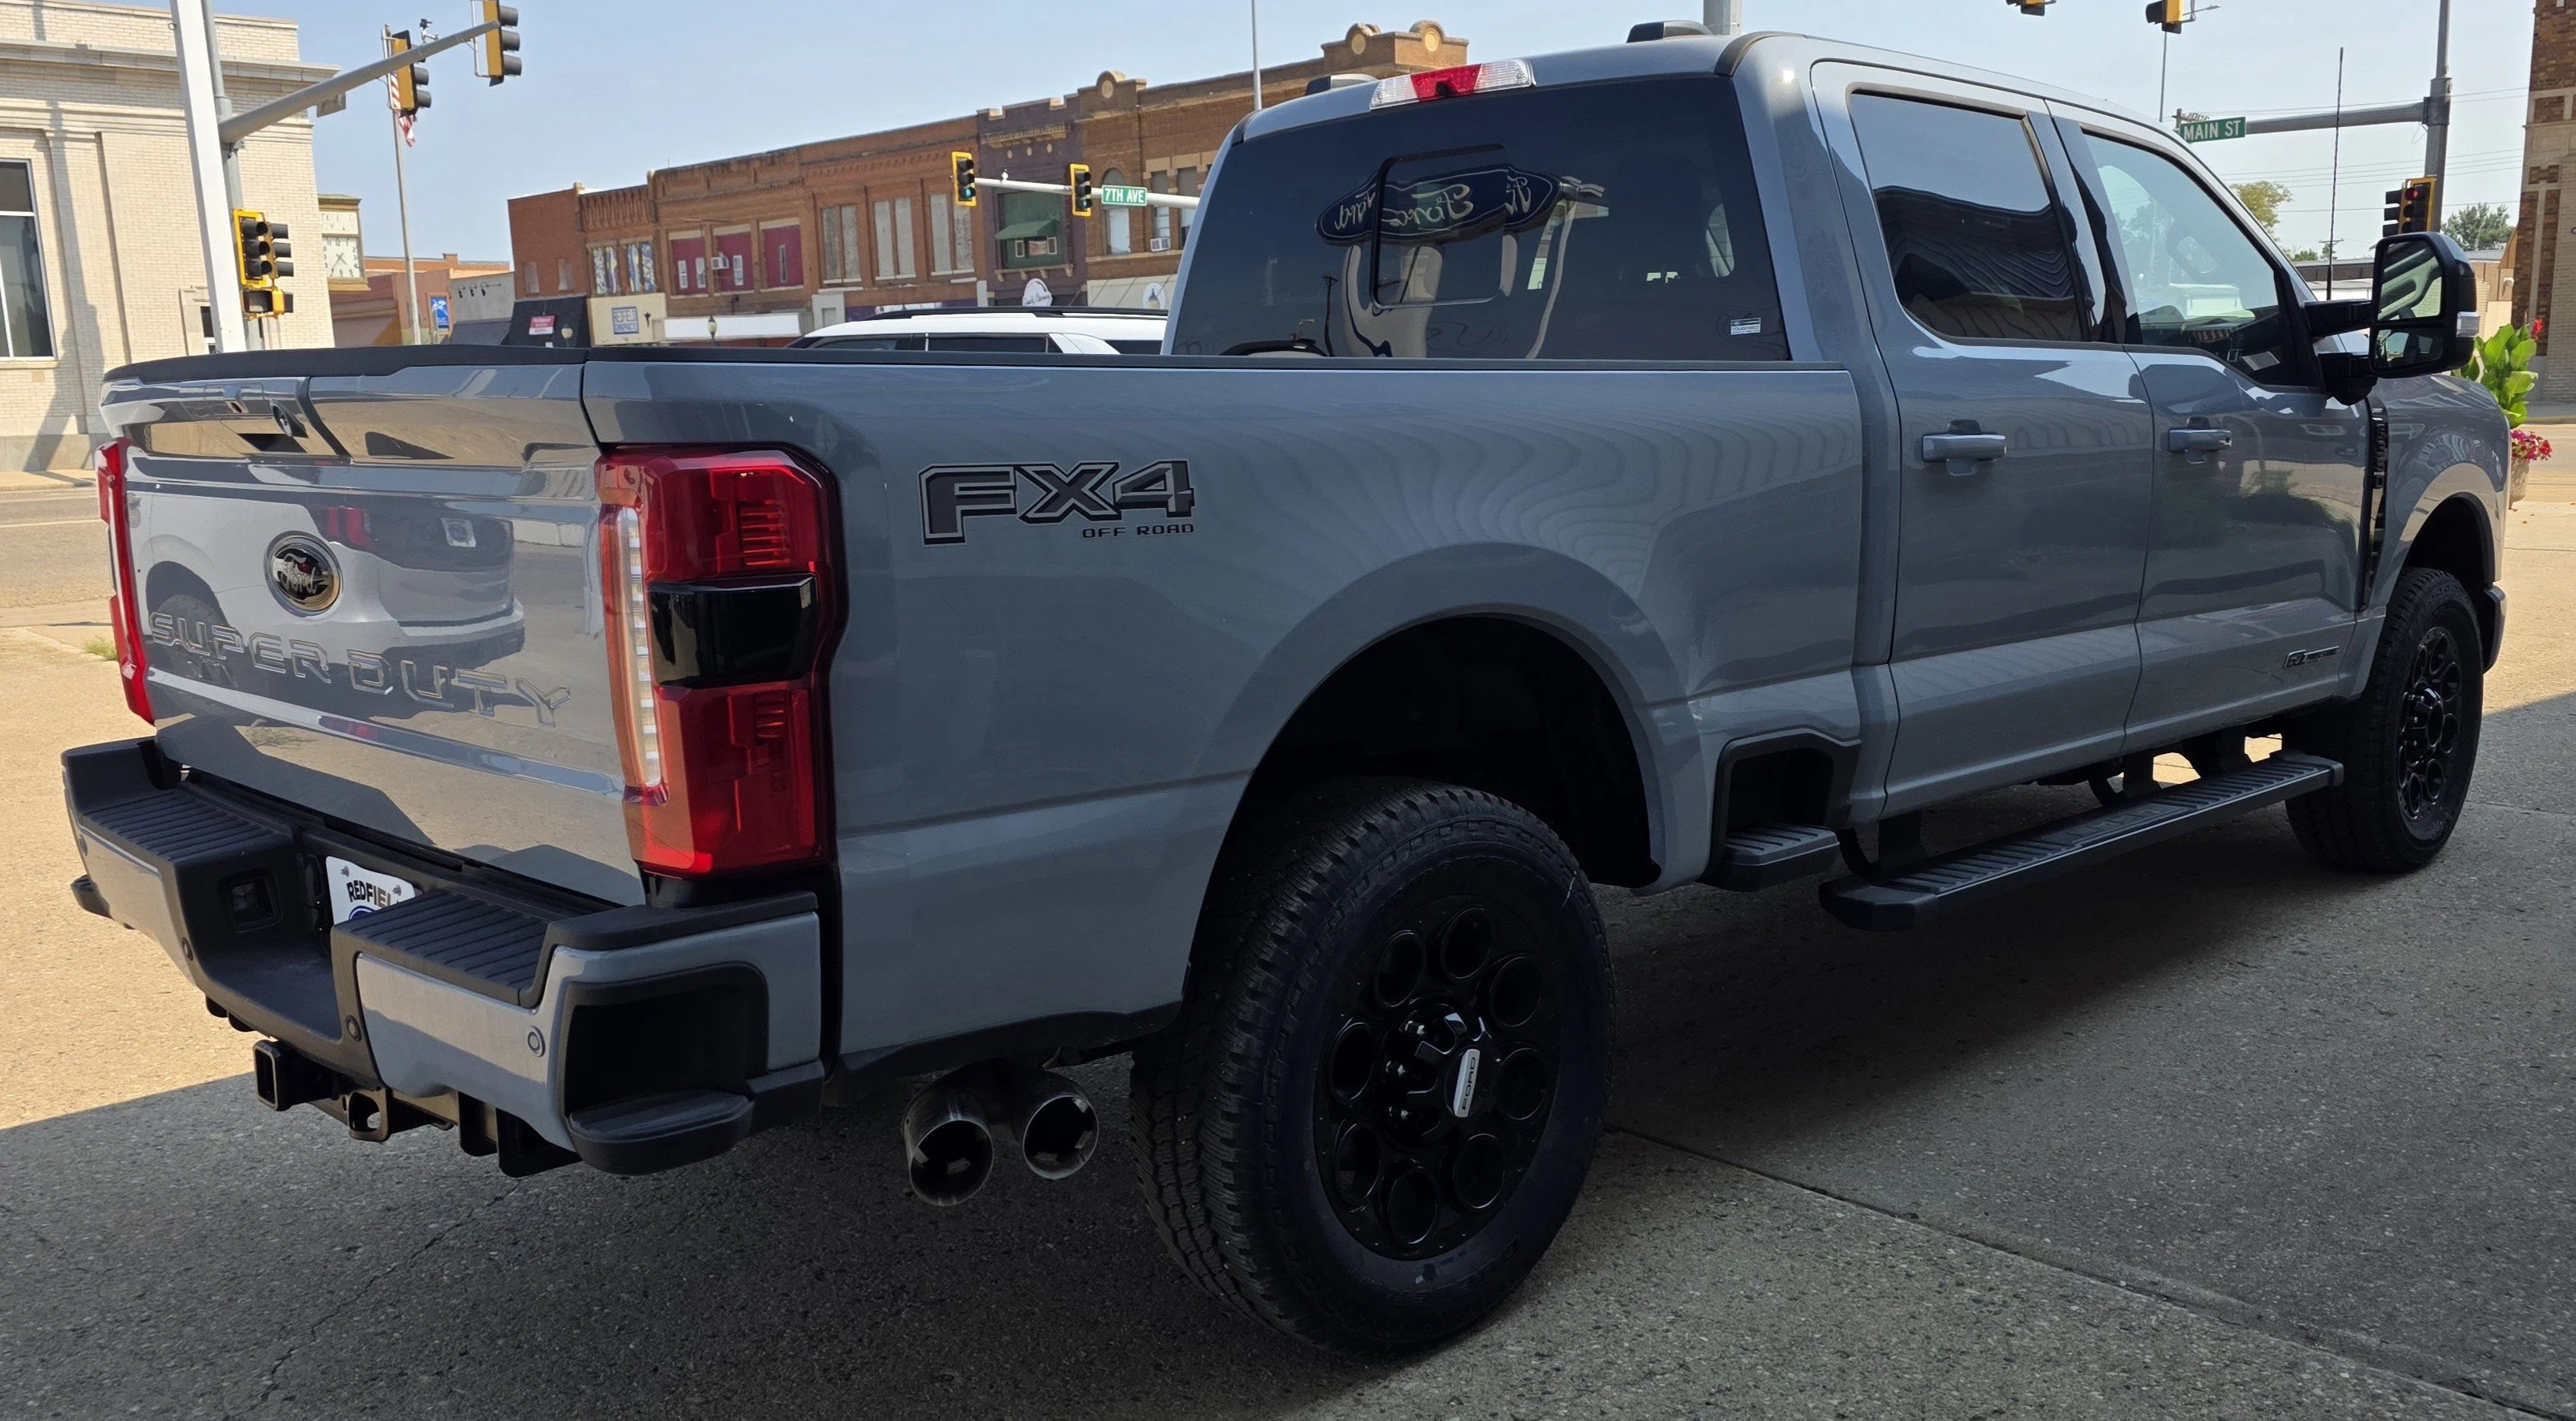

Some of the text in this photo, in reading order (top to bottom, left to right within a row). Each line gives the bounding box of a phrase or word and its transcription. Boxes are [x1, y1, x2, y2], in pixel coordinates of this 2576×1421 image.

[2184, 120, 2242, 140] MAIN ST
[1104, 188, 1145, 203] 7TH AVE
[918, 459, 1196, 546] FX4
[1082, 524, 1195, 539] OFF ROAD
[149, 611, 572, 728] SUPER DUTY
[1462, 1057, 1476, 1110] FORD
